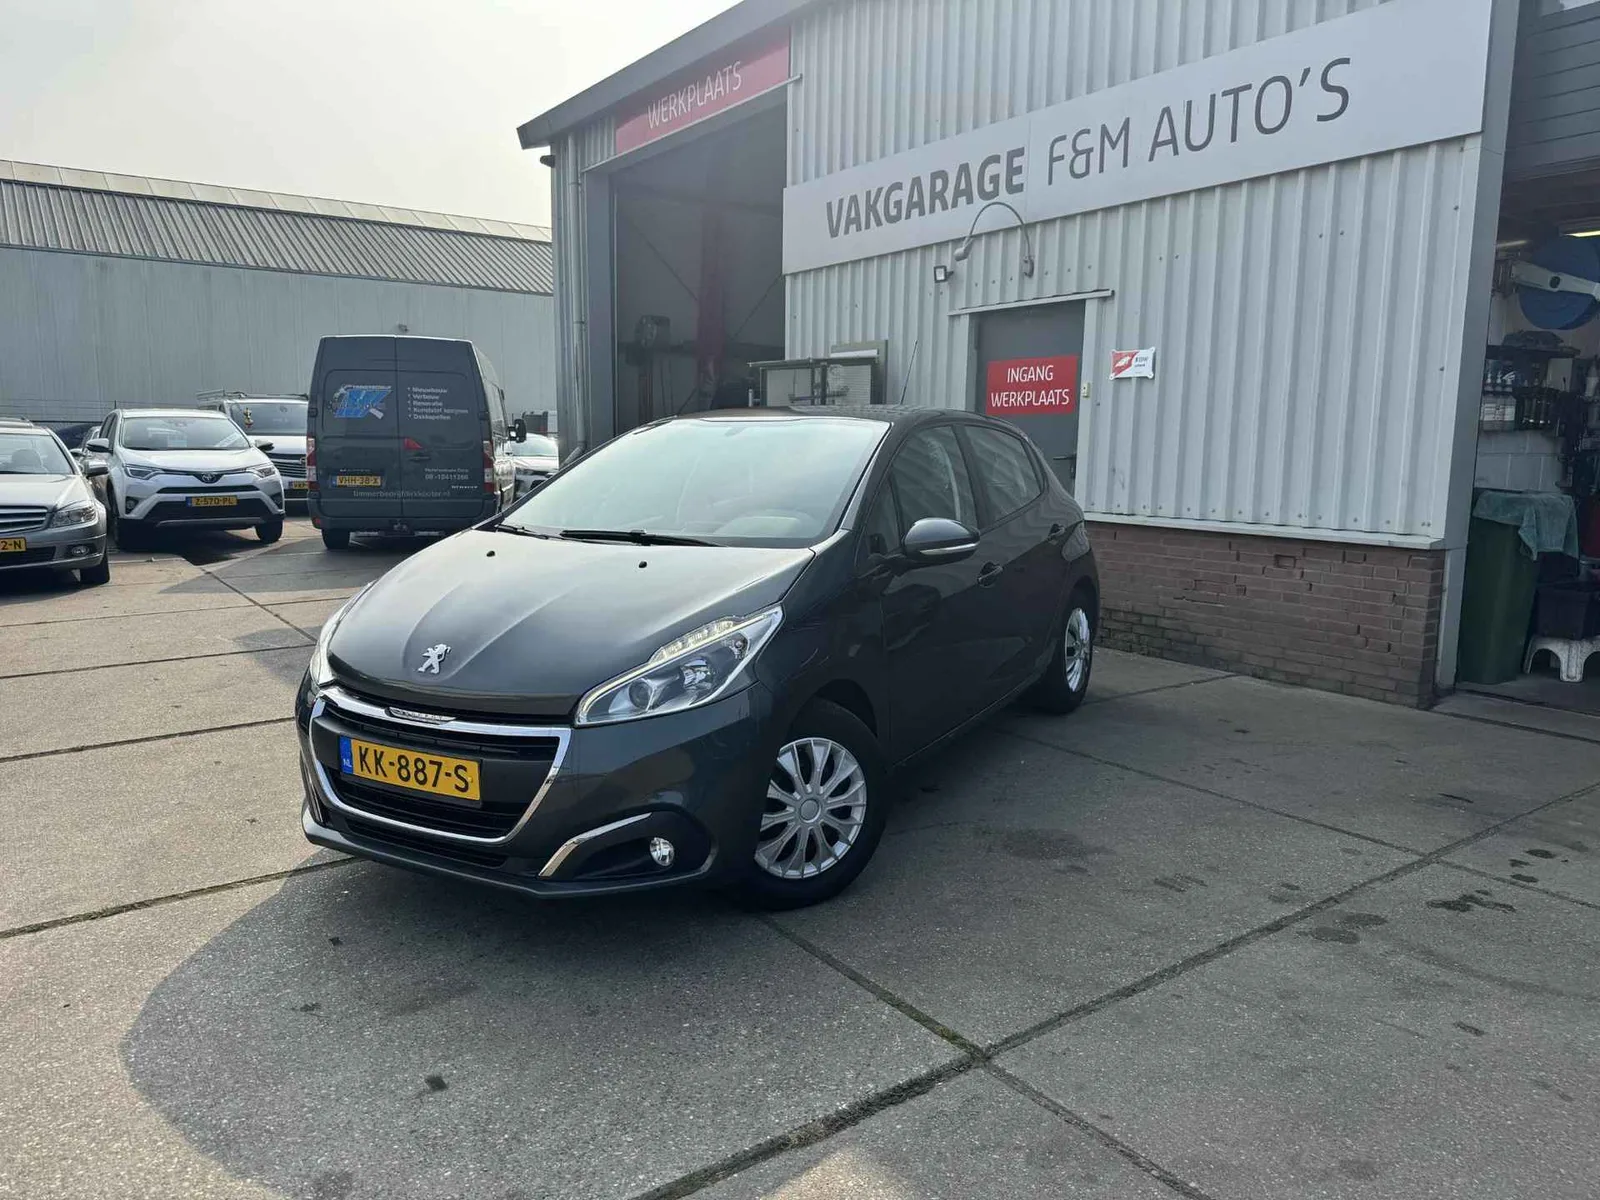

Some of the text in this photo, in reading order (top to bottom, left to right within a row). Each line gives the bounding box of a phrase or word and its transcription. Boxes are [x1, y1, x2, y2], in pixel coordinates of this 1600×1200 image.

[647, 60, 742, 129] WERKPLAATS
[826, 57, 1350, 239] VAKGARAGE F&M AUTO'S
[1007, 365, 1054, 383] INGANG
[991, 389, 1070, 407] WERKPLAATS
[195, 497, 234, 506] Z-570-PL
[358, 746, 470, 793] KK-887-S
